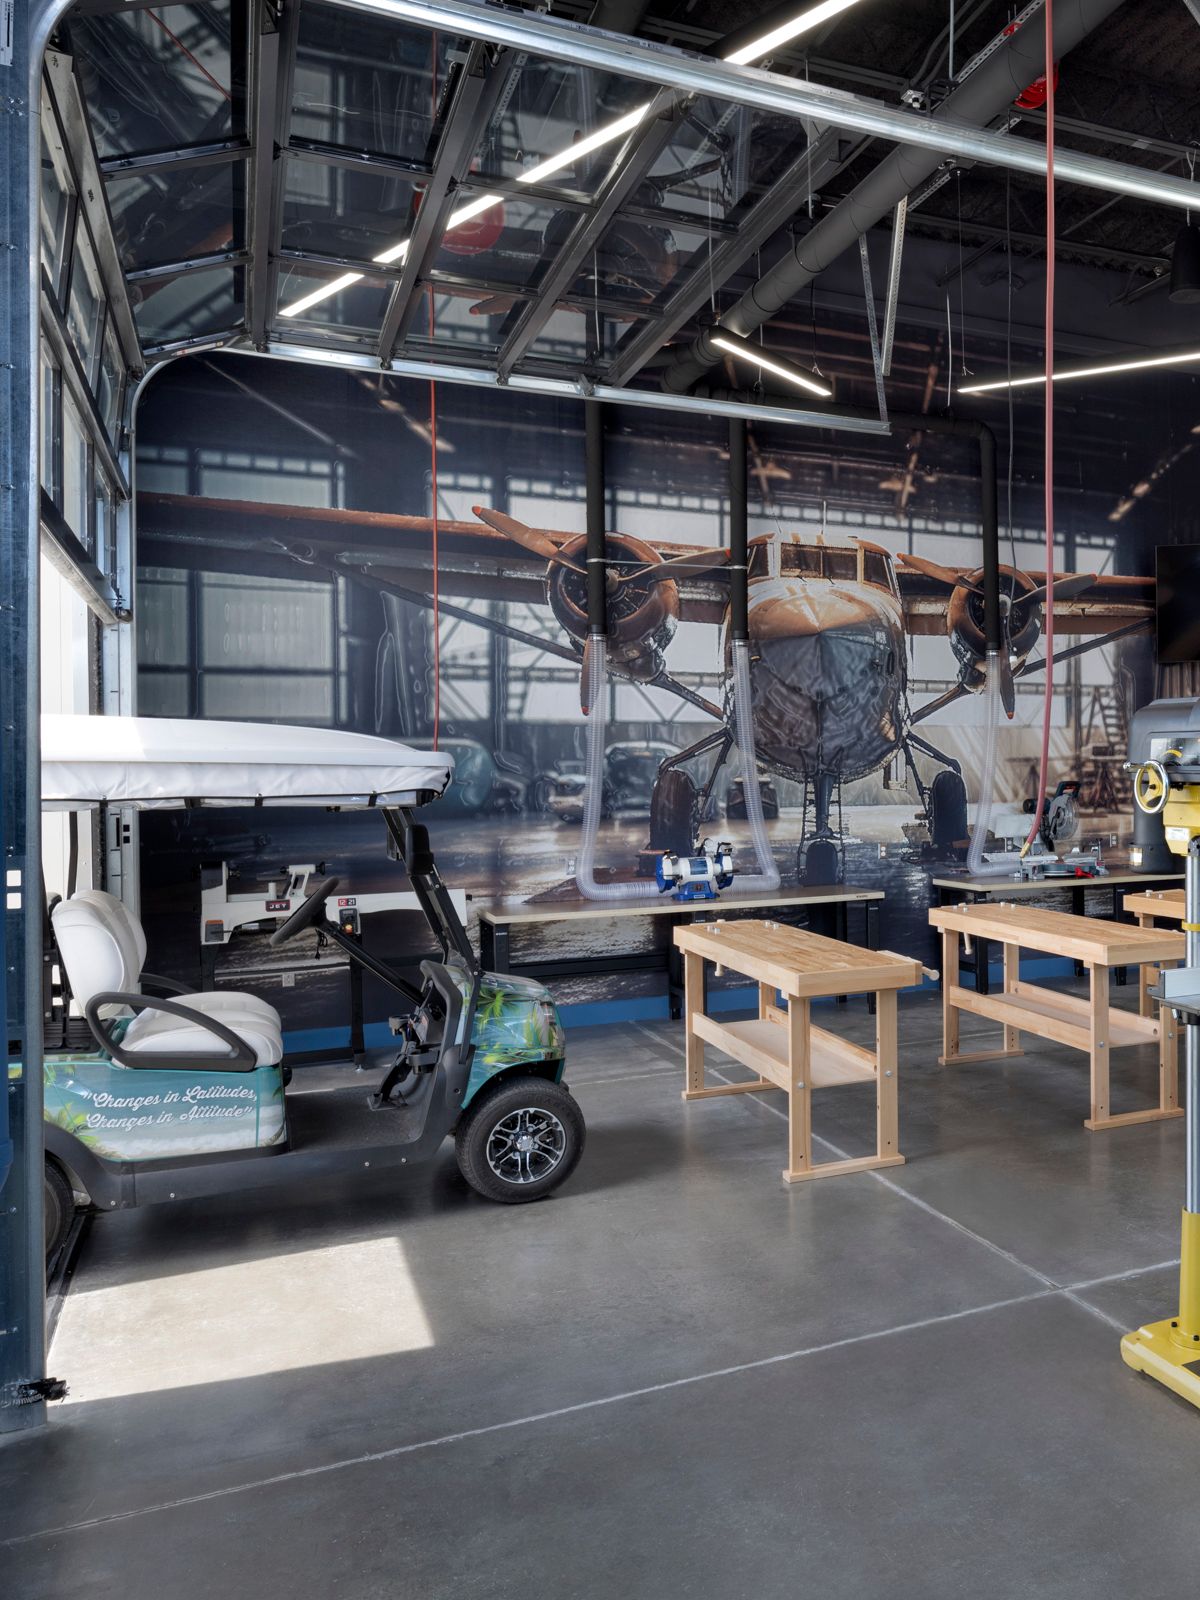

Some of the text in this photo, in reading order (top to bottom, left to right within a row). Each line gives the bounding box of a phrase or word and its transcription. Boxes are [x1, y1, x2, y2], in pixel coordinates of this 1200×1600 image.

[82, 1085, 258, 1112] "Changes in Latitudes,
[86, 1105, 253, 1131] Changes in Attitude"
